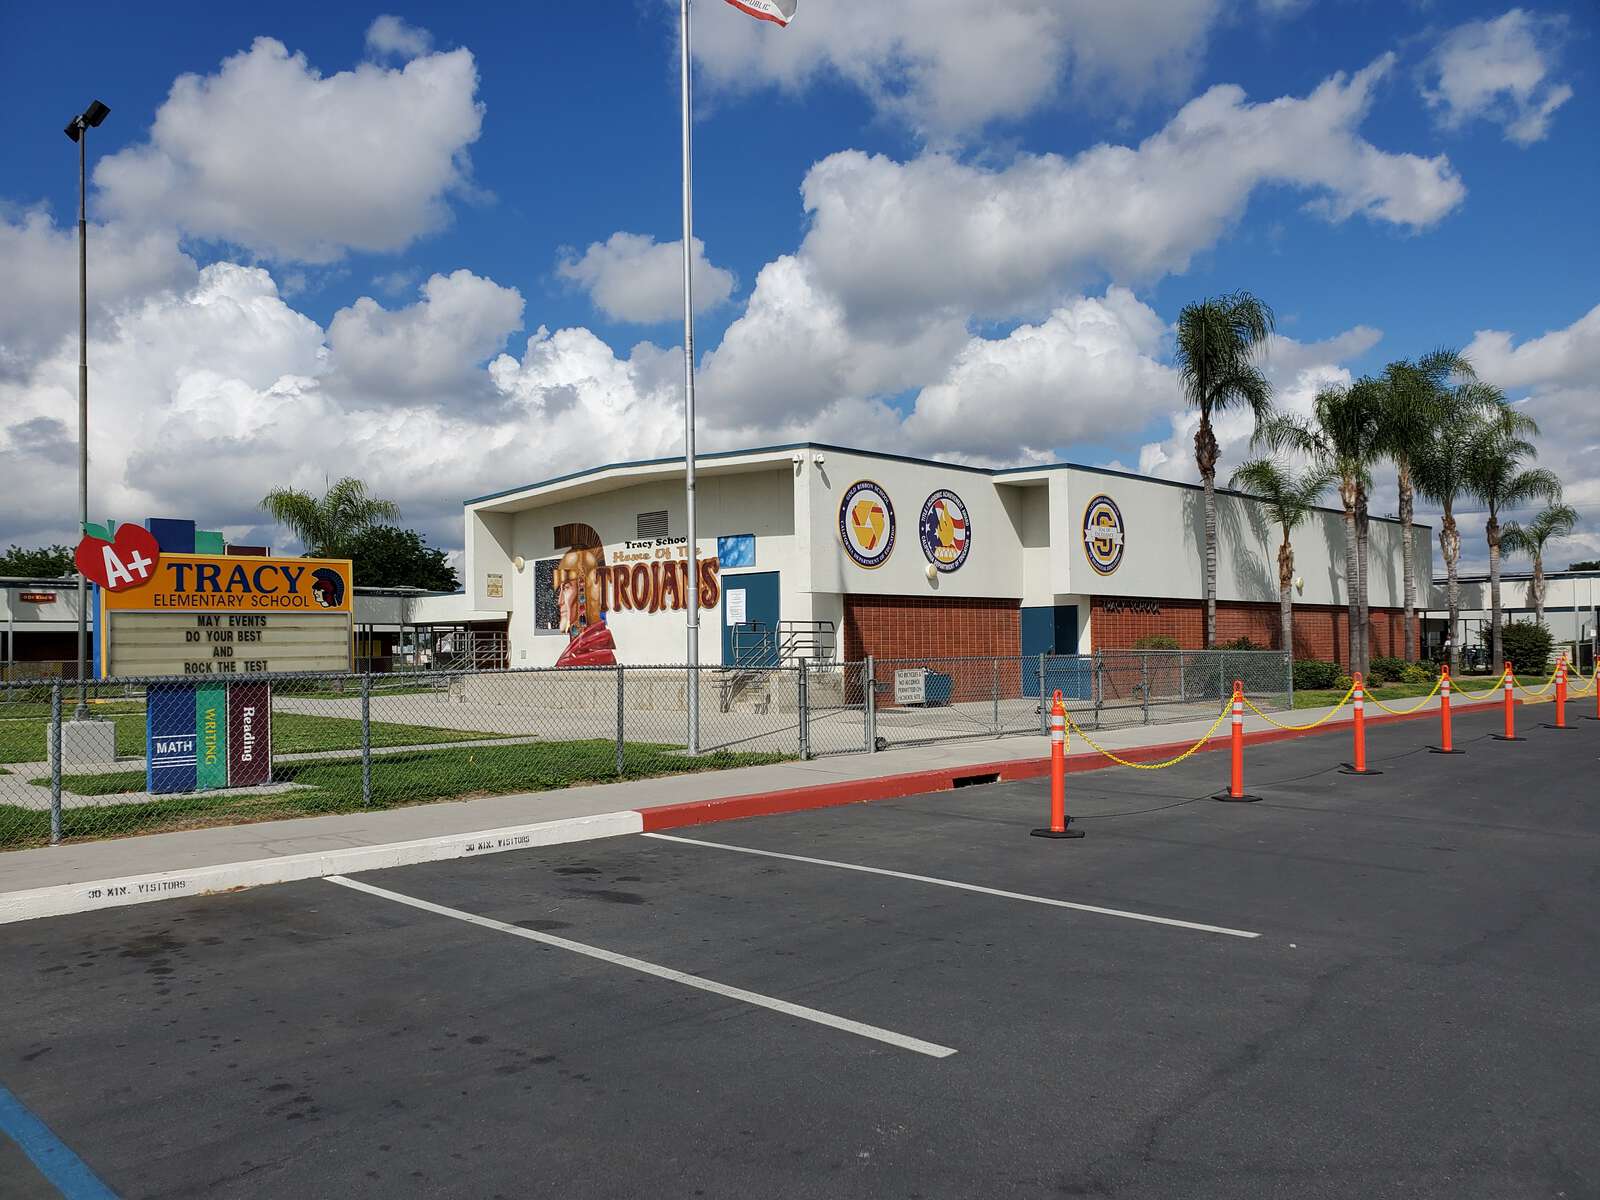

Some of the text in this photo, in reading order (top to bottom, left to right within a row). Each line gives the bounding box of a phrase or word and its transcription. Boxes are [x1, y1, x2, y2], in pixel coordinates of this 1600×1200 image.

[874, 486, 889, 504] SCHOOL
[625, 536, 688, 549] Tracy Schoo
[841, 520, 854, 555] CALIFORNIA
[853, 553, 880, 565] DEPARTMENT
[884, 525, 895, 555] EDUCATION
[613, 551, 651, 563] Home
[655, 547, 671, 560] Of
[102, 545, 152, 588] A+
[166, 563, 305, 594] TRACY
[596, 557, 720, 614] TROJANS
[154, 594, 309, 607] ELEMENTARY SCHOOL
[197, 616, 267, 626] MAY EVENTS
[186, 631, 262, 641] DO YOUR BEST
[213, 646, 234, 657] AND
[184, 661, 268, 674] ROCK THE TEST
[205, 708, 217, 765] WRITING
[241, 706, 255, 762] Reading
[157, 741, 192, 754] MATH
[498, 836, 530, 847] VISITORS
[89, 890, 101, 899] 30
[138, 880, 185, 893] VISITORS
